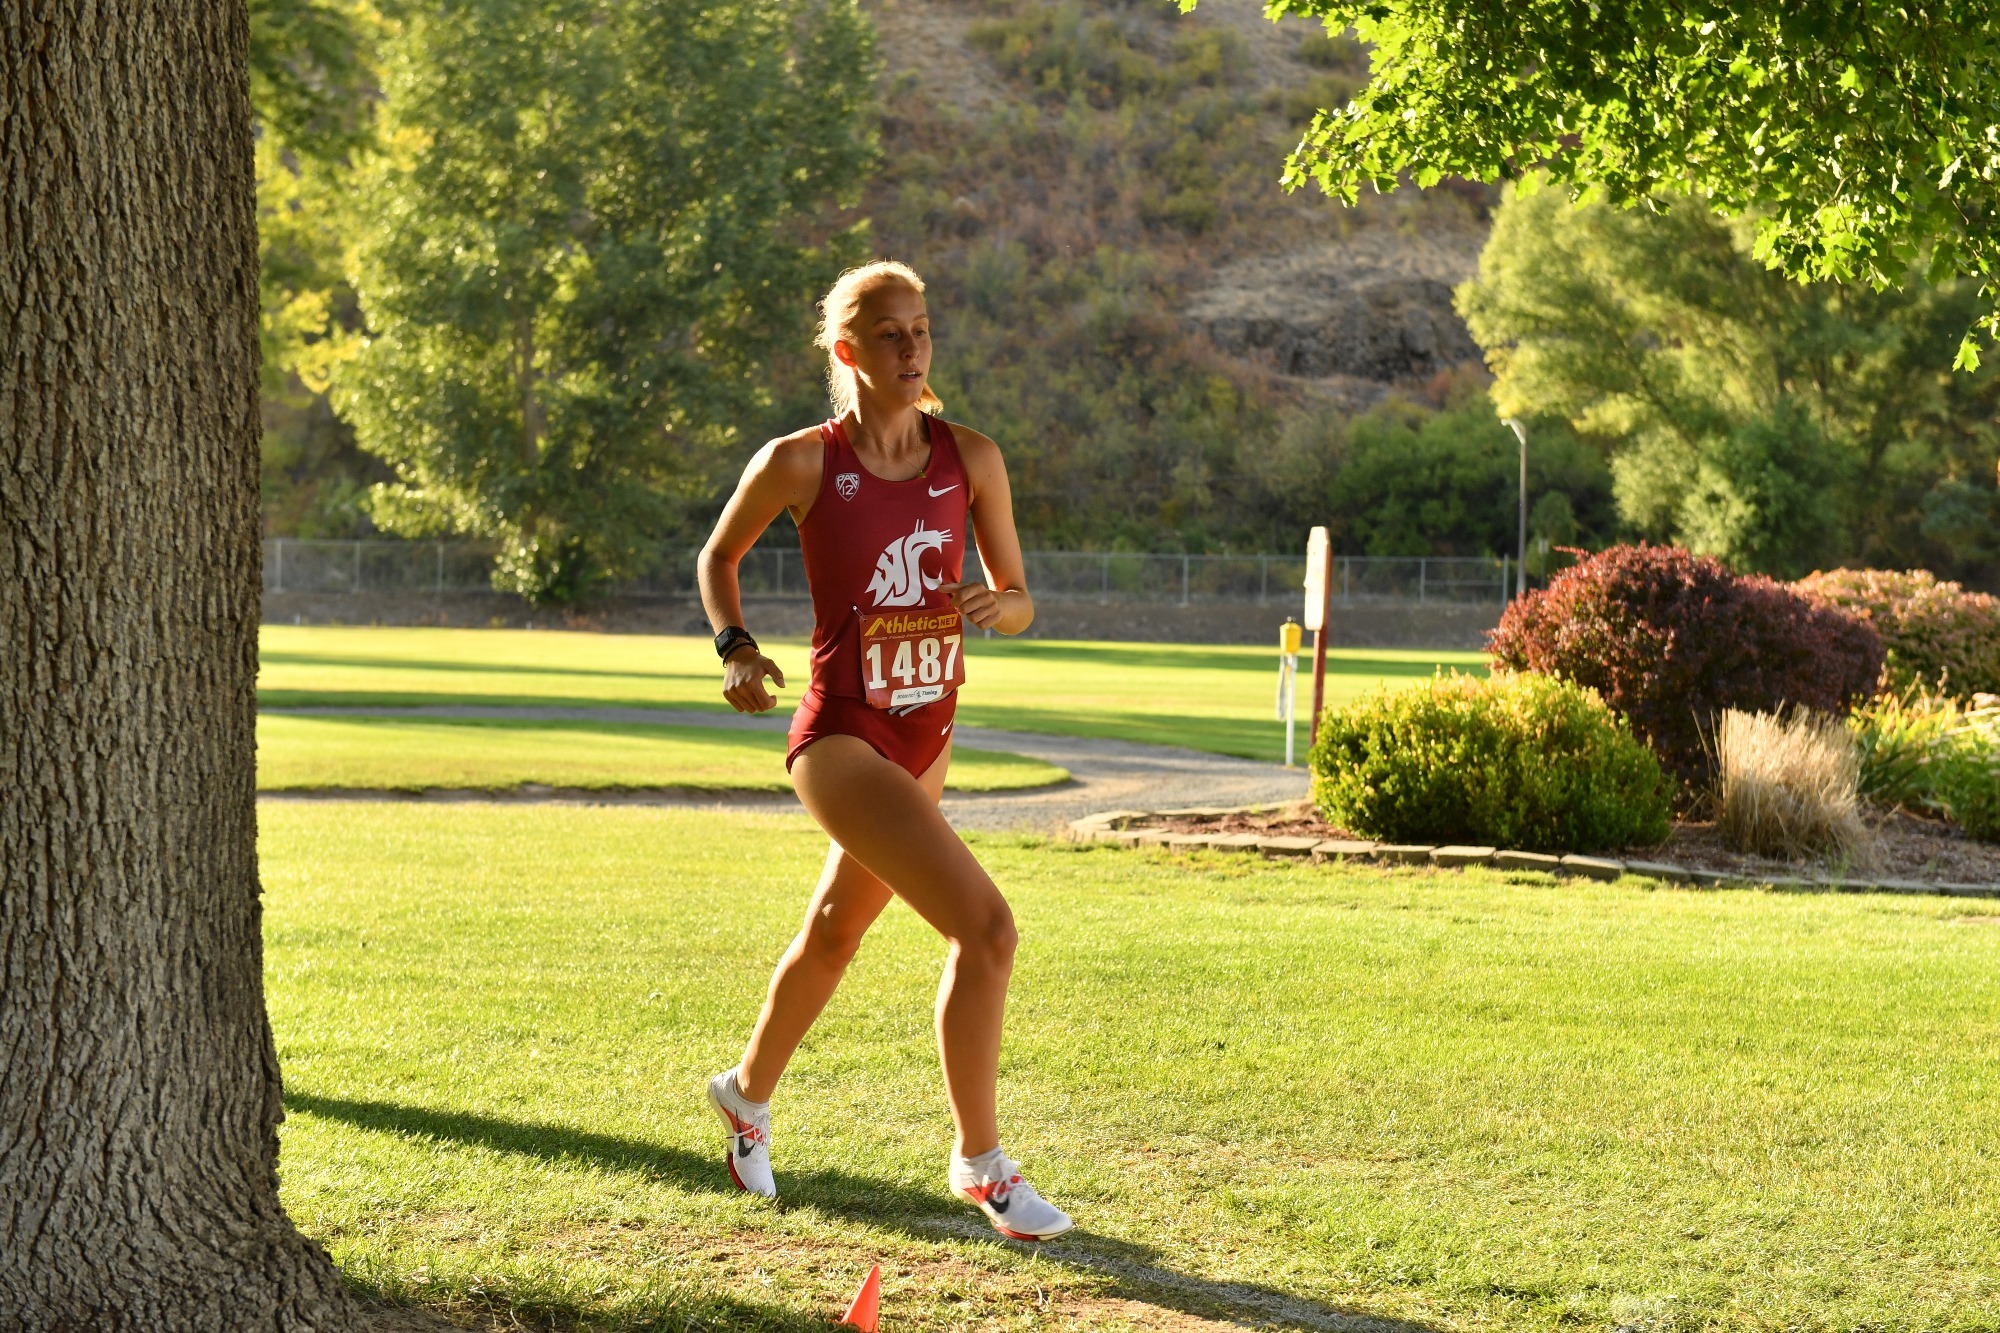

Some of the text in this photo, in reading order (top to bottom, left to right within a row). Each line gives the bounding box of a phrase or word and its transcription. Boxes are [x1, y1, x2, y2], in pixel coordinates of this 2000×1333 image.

[837, 474, 858, 490] PAC
[842, 485, 854, 495] 12
[864, 615, 938, 636] Athletic
[866, 634, 961, 690] 1487
